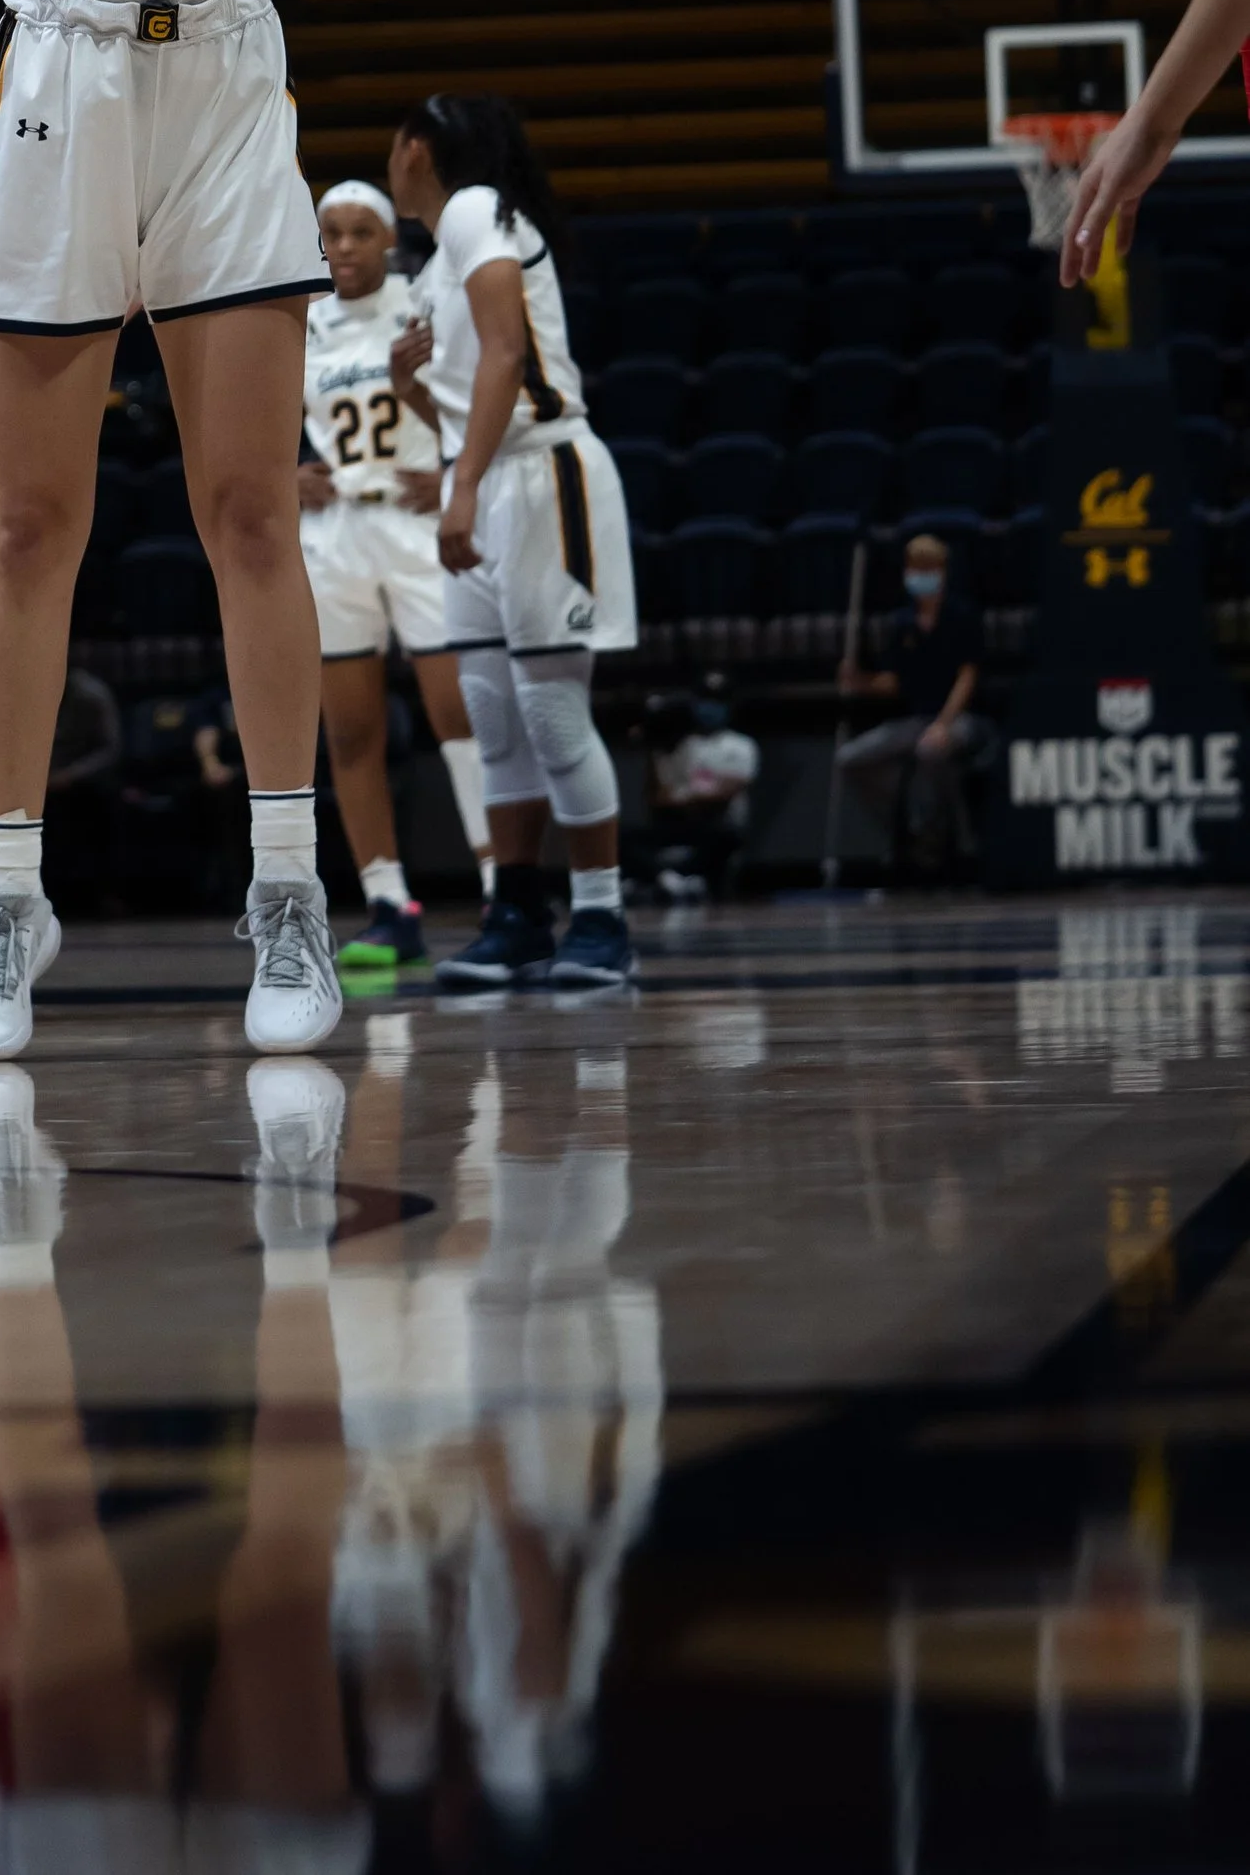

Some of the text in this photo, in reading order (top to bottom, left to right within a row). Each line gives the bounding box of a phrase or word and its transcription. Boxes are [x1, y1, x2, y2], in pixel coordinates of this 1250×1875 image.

[330, 391, 402, 466] 22
[1080, 468, 1155, 527] Cal
[567, 604, 594, 631] Cal
[1008, 733, 1241, 808] MUSCLE
[1054, 800, 1206, 873] MILK
